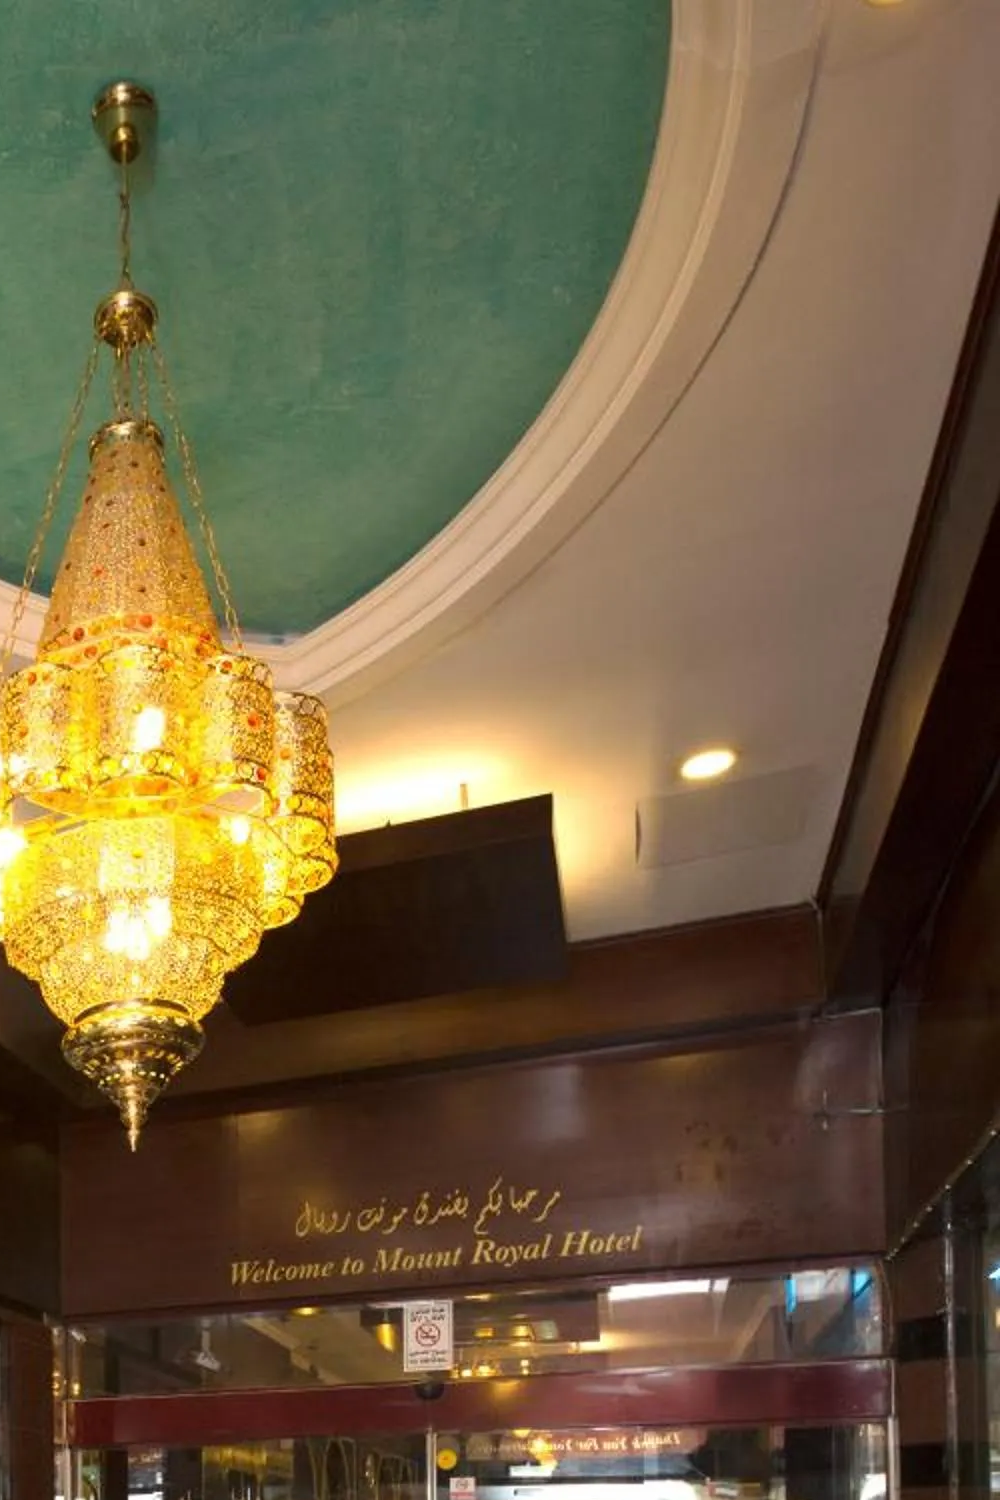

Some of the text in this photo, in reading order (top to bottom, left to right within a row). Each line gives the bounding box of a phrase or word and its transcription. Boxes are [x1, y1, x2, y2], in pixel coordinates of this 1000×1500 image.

[295, 1199, 351, 1238] رويال
[356, 1197, 408, 1236] مونت
[413, 1188, 469, 1226] بفندق
[472, 1175, 503, 1236] بكم
[231, 1224, 644, 1286] Welcome to Mount Royal Hotel
